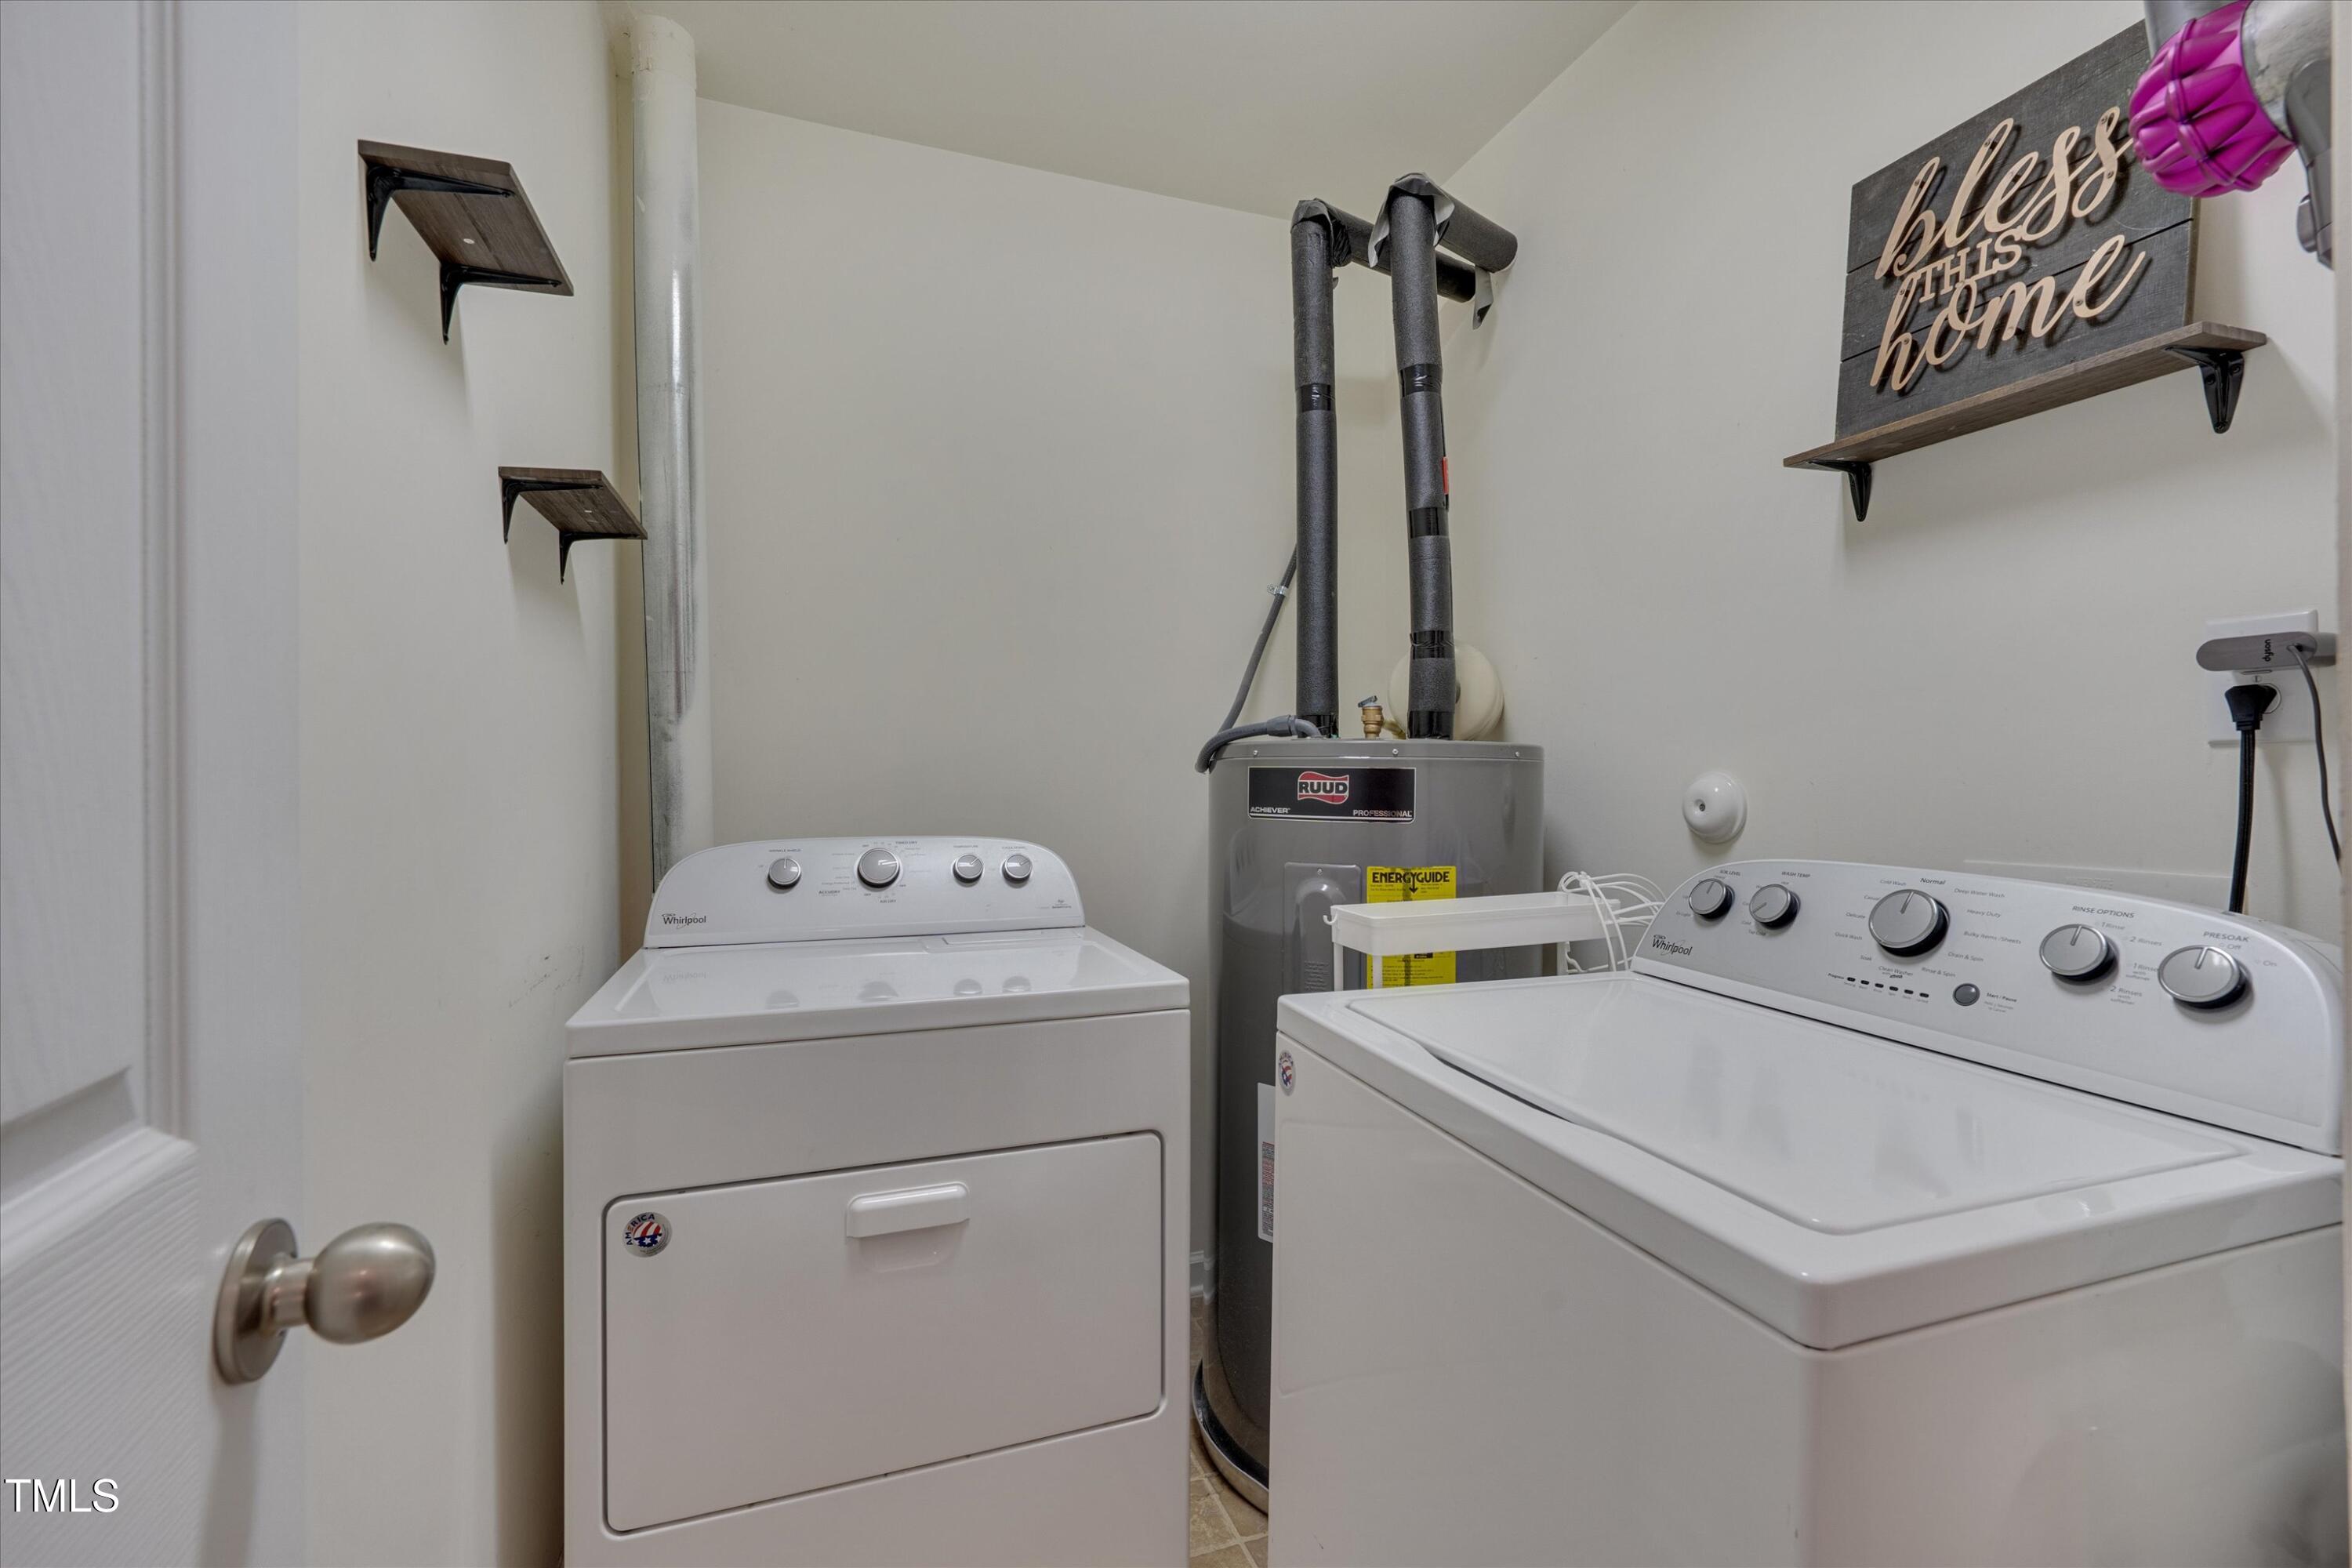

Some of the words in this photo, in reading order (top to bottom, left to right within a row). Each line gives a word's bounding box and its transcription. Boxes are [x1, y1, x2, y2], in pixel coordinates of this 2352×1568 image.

[1875, 107, 2134, 280] bless
[1918, 227, 2024, 304] THIS
[1870, 234, 2147, 391] home
[2261, 638, 2274, 662] dyson
[1298, 781, 1348, 795] RUUD
[1352, 809, 1412, 818] PROFESSIONAL
[1372, 871, 1450, 884] ENERGYGUIDE
[1920, 877, 1947, 886] Normal
[1986, 910, 2002, 919] Duty
[2072, 905, 2096, 915] RINSE
[2096, 908, 2136, 919] OPTIONS
[662, 915, 706, 927] Whirlpool
[2203, 931, 2250, 943] PRESOAK
[1652, 938, 1693, 956] Whirlpool
[2262, 959, 2278, 967] On
[1921, 966, 1936, 975] Rinse
[2118, 986, 2143, 997] Rinses
